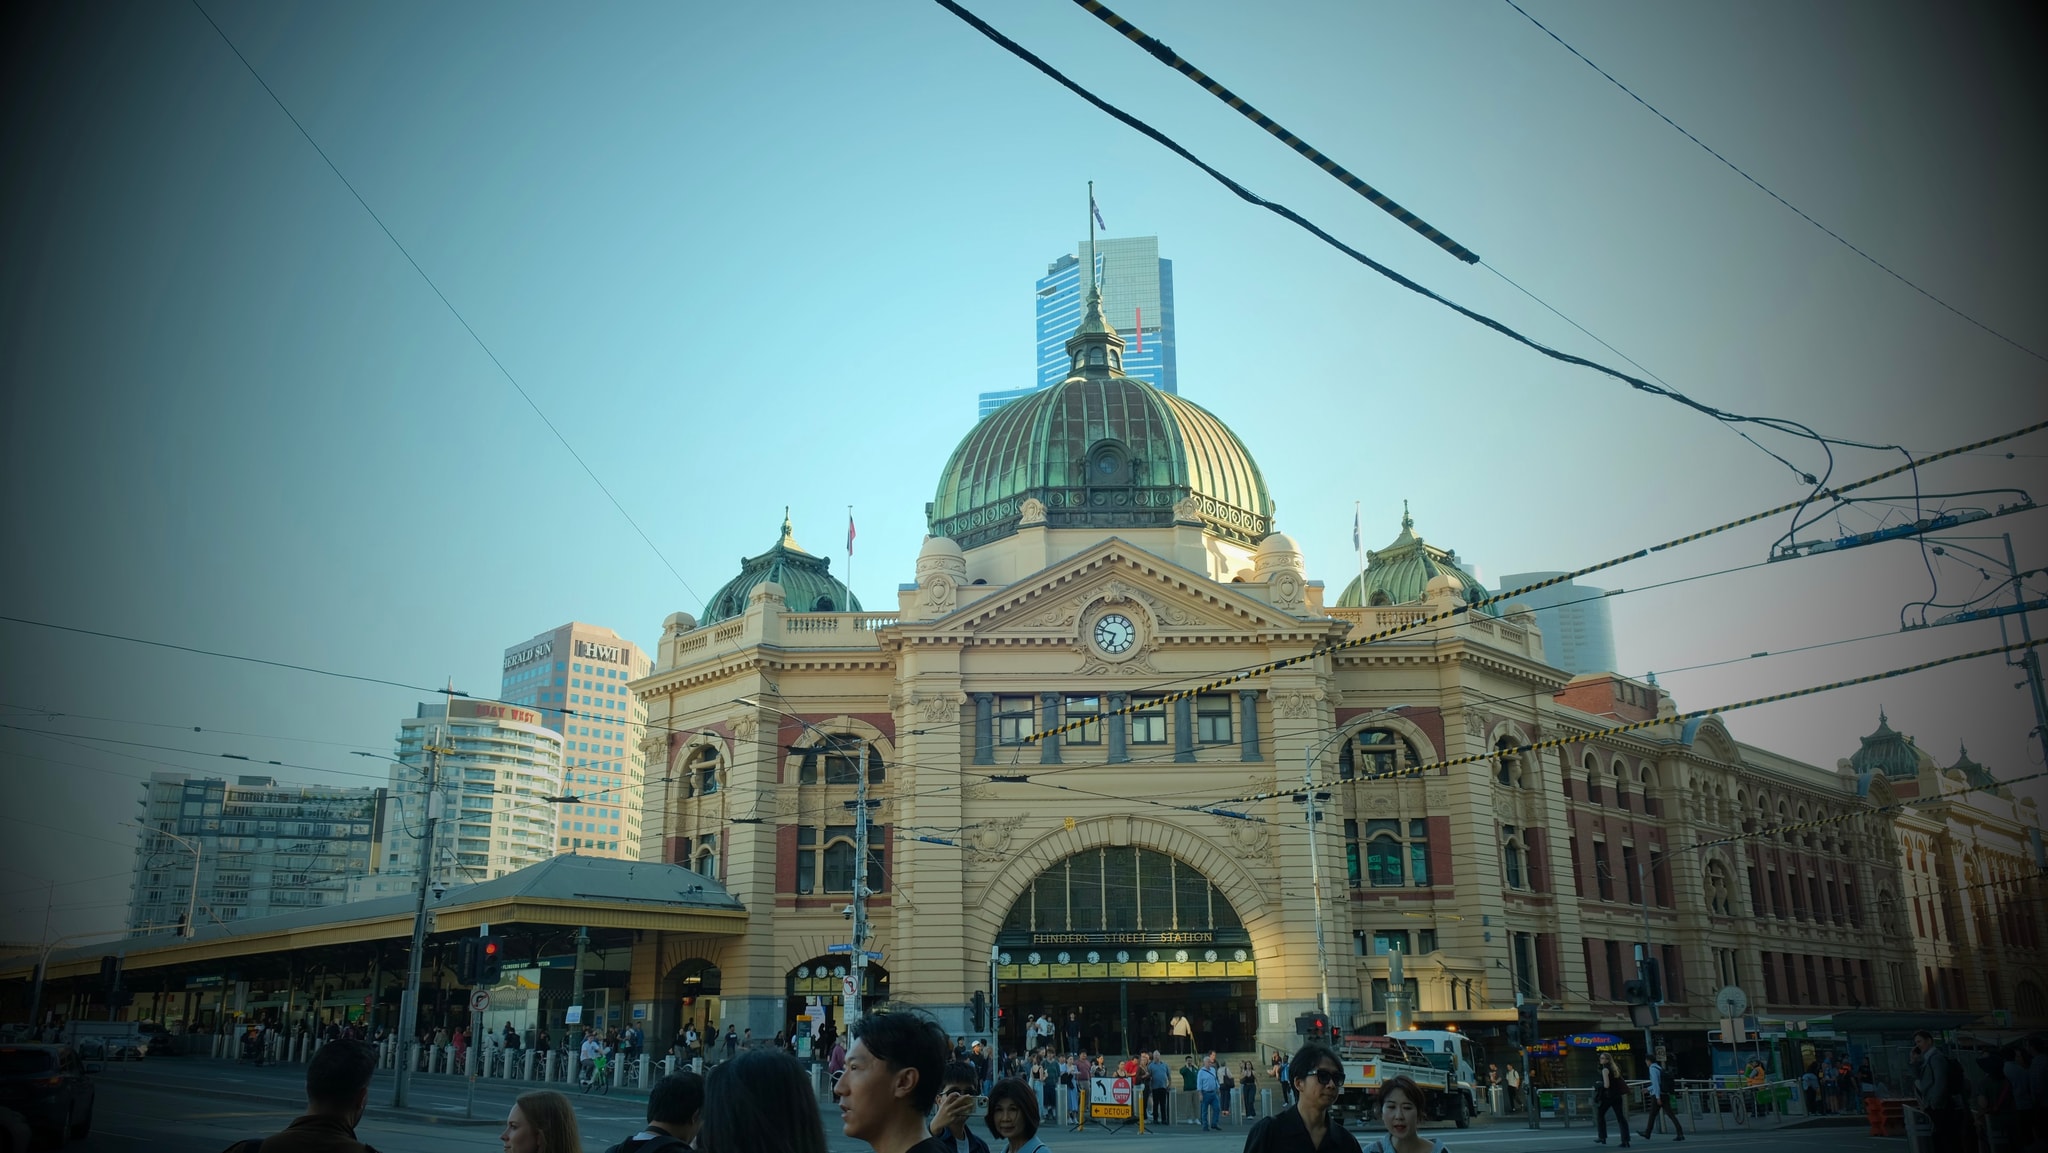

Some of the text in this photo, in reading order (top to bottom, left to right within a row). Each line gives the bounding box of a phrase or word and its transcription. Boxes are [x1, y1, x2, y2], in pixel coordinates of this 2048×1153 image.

[534, 640, 551, 659] SUN
[585, 642, 620, 661] HWT
[511, 709, 535, 724] WEST
[1033, 932, 1213, 944] FLINDERS STREET STATION
[1104, 1107, 1130, 1116] DETOUR
